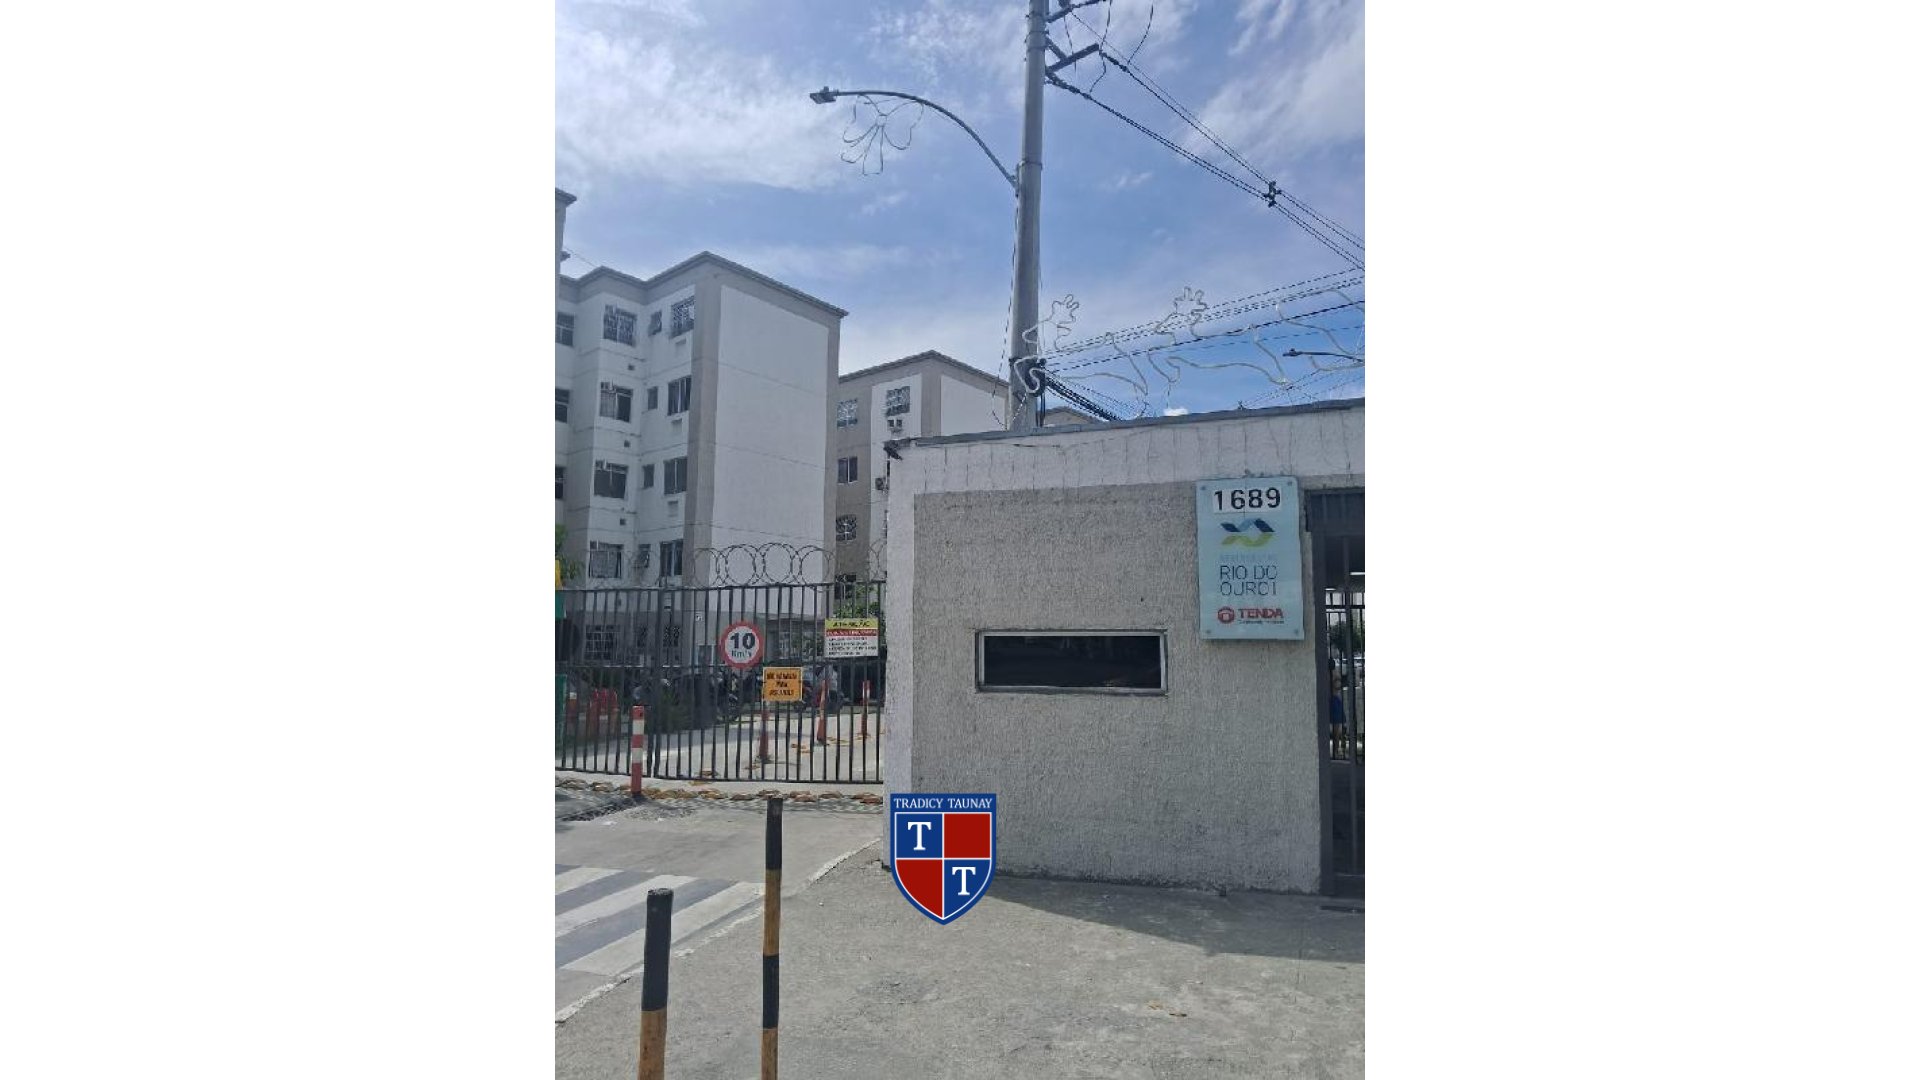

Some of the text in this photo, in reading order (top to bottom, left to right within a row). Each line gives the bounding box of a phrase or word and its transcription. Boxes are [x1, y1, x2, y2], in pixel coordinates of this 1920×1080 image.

[1214, 487, 1281, 511] 1689
[1220, 565, 1278, 580] RIO DO
[1220, 581, 1270, 596] OURO
[1238, 608, 1284, 619] TENDA
[730, 632, 756, 650] 10
